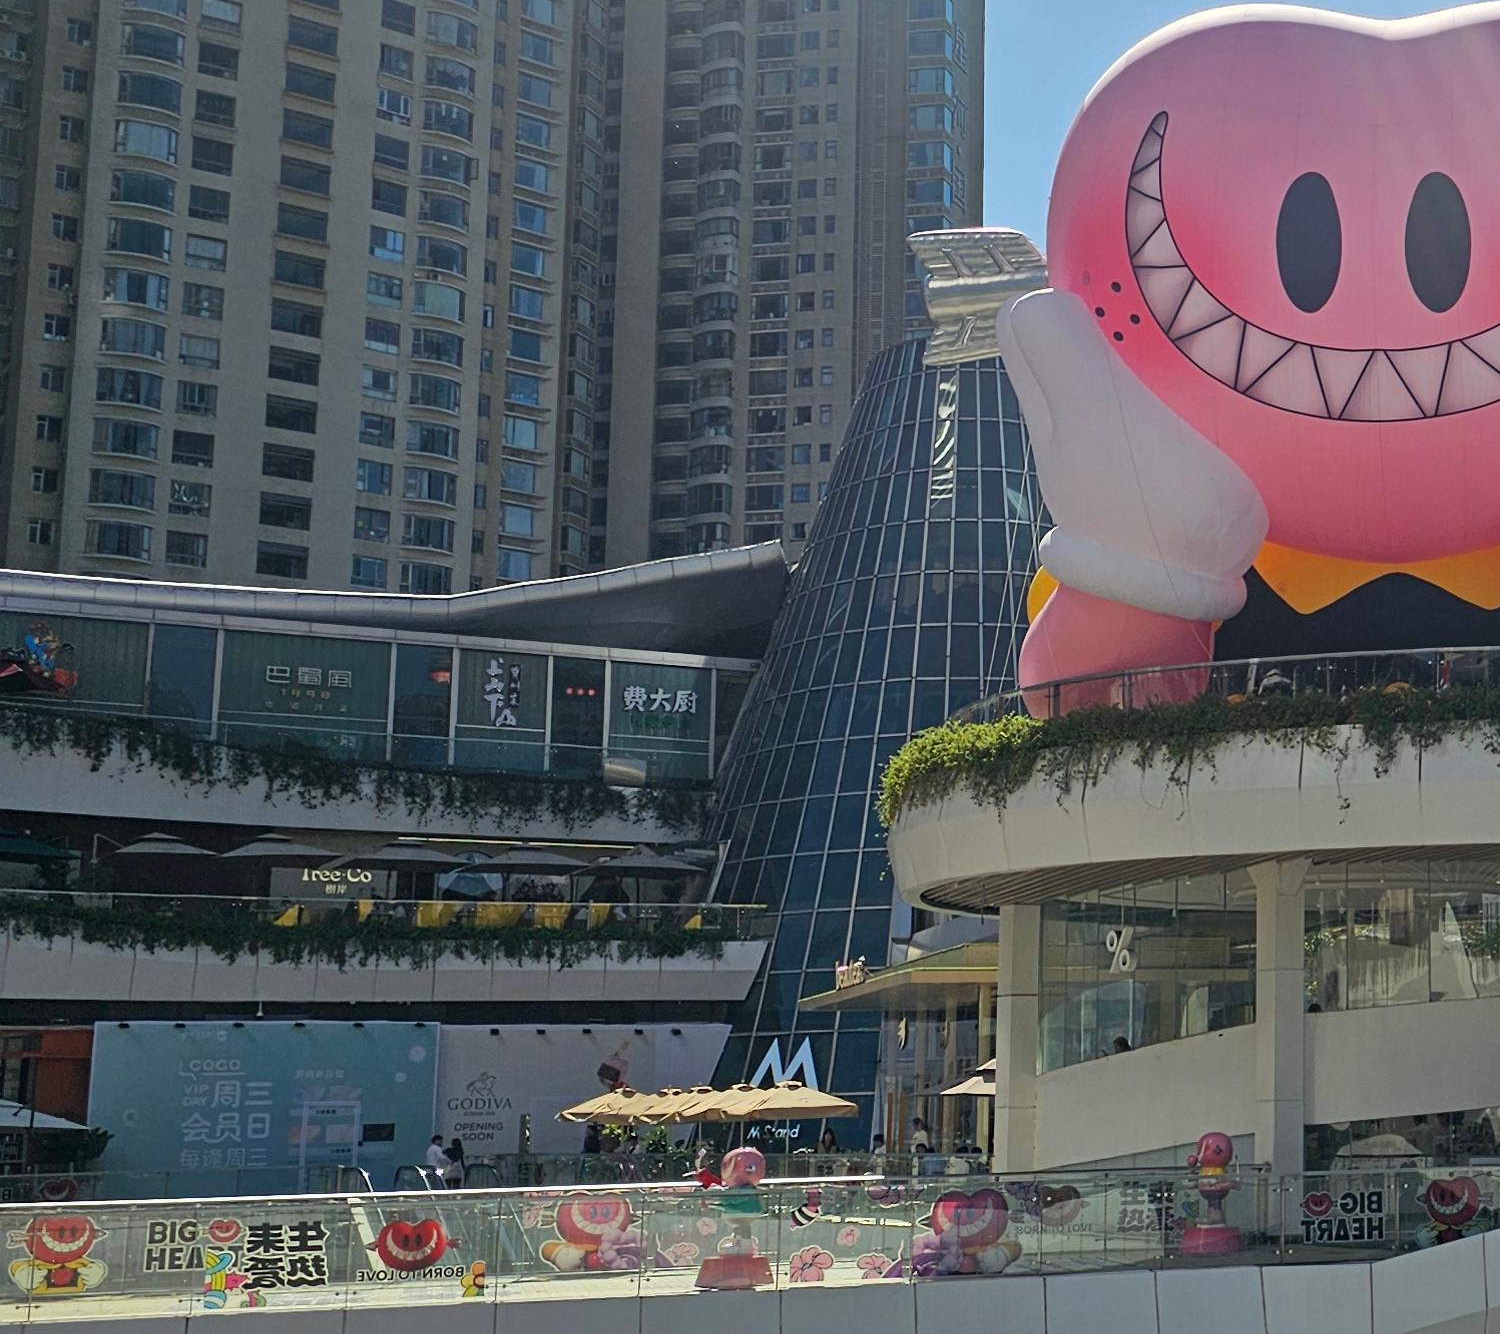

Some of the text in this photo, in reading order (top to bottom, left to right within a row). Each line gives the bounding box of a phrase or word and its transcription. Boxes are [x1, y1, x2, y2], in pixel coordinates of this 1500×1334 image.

[623, 686, 699, 715] 费大厨
[184, 1083, 210, 1095] VIP
[211, 1080, 273, 1108] 周三
[447, 1097, 513, 1111] GODIVA
[181, 1112, 272, 1143] 会员日
[454, 1122, 504, 1131] OPENING
[462, 1132, 495, 1141] SOON
[148, 1220, 198, 1245] BIG
[1016, 1224, 1046, 1236] BORN
[145, 1245, 243, 1271] HEAT
